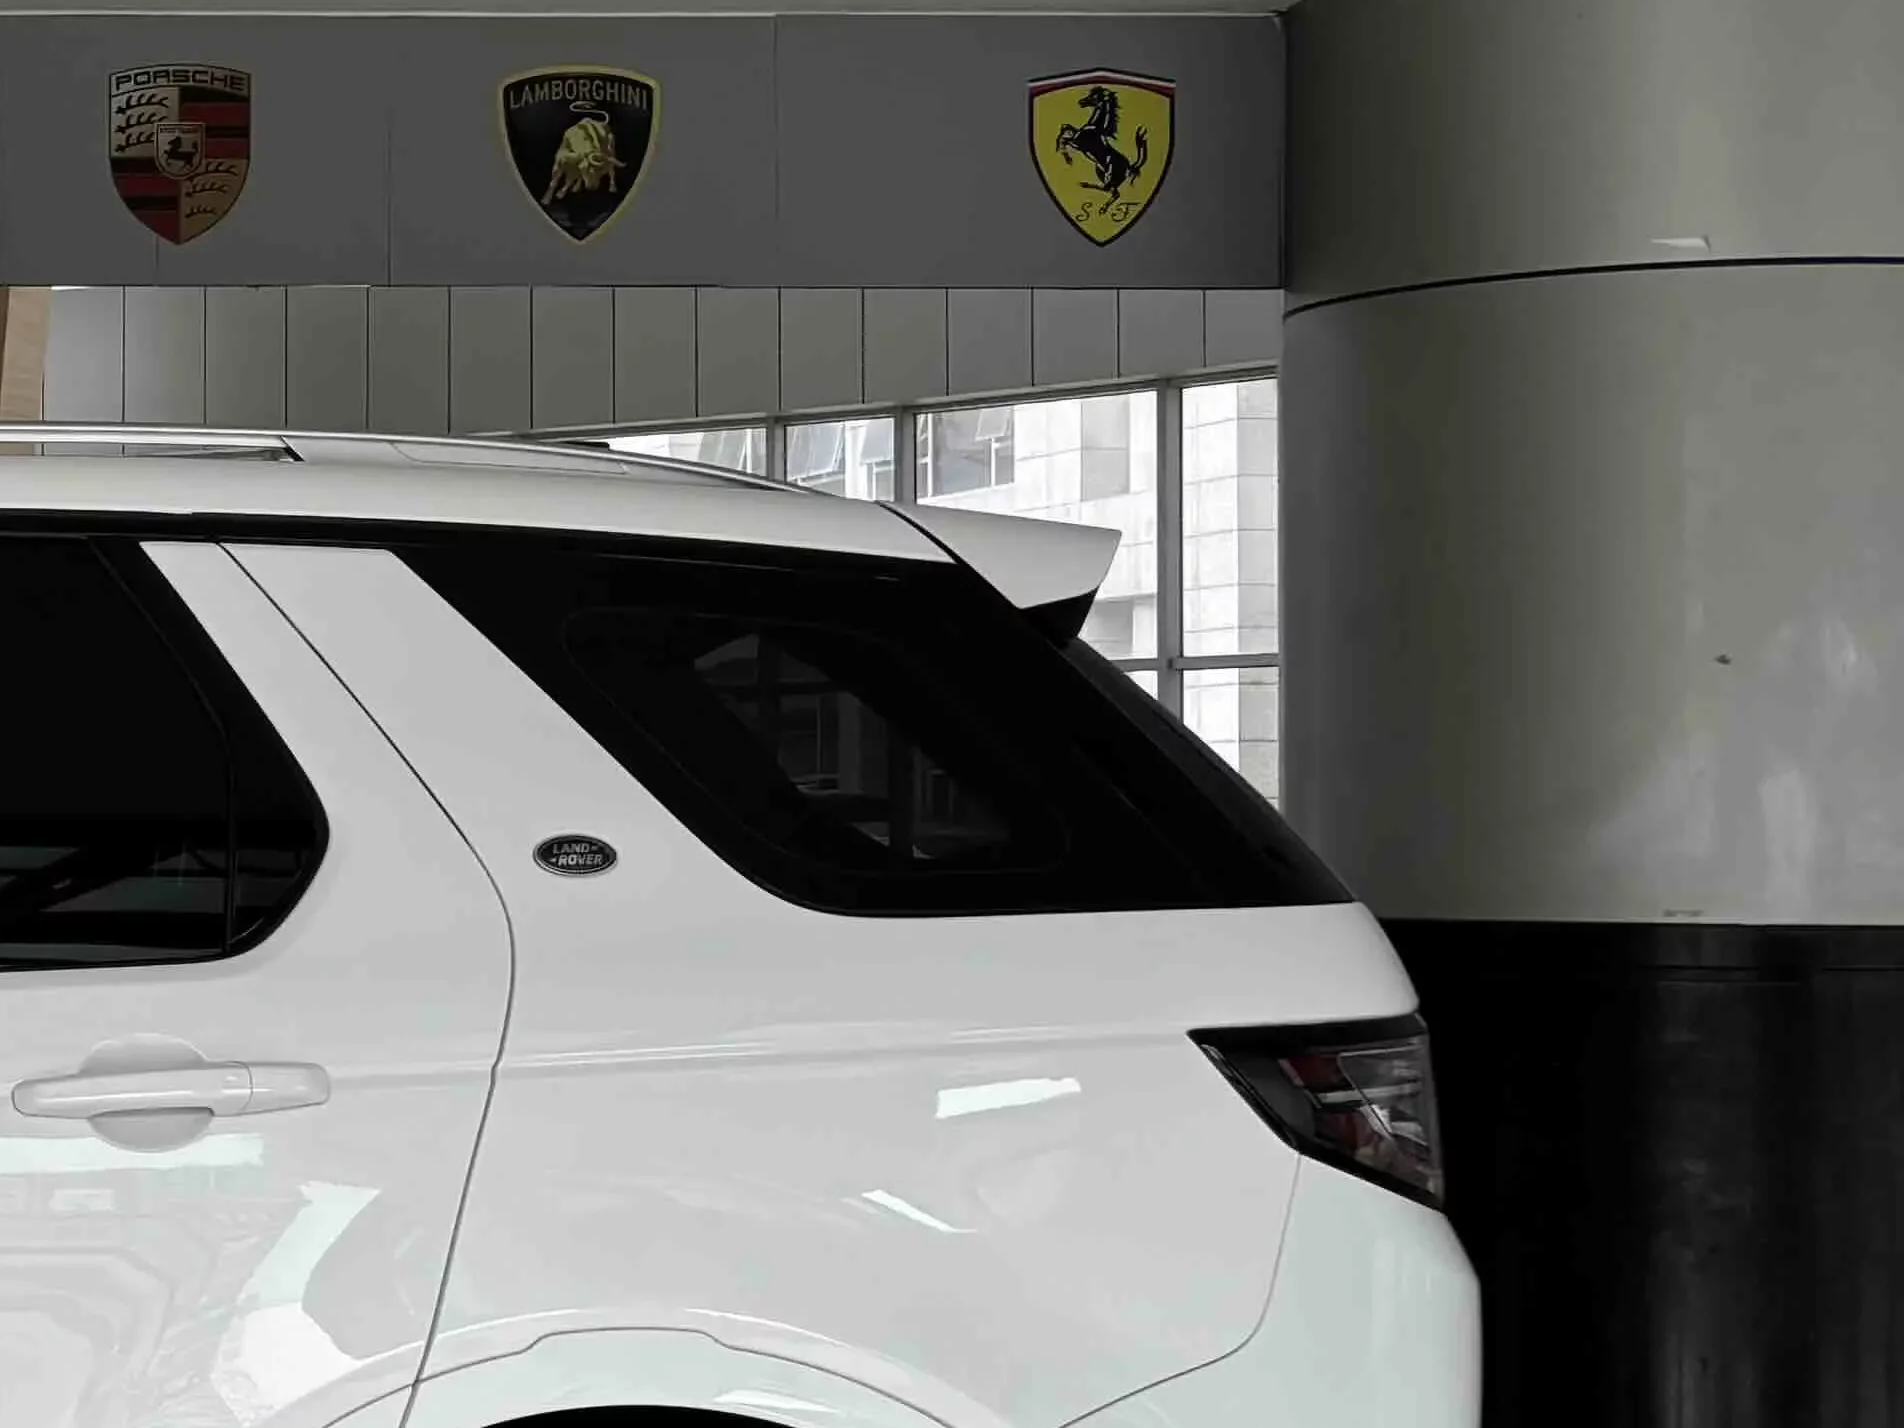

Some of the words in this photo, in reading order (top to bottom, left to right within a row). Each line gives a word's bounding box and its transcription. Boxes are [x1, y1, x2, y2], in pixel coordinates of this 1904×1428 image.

[114, 68, 246, 92] PORSCHE
[509, 80, 649, 113] LAMBORGHINI
[553, 843, 590, 853] LAND
[557, 854, 603, 866] ROVER
